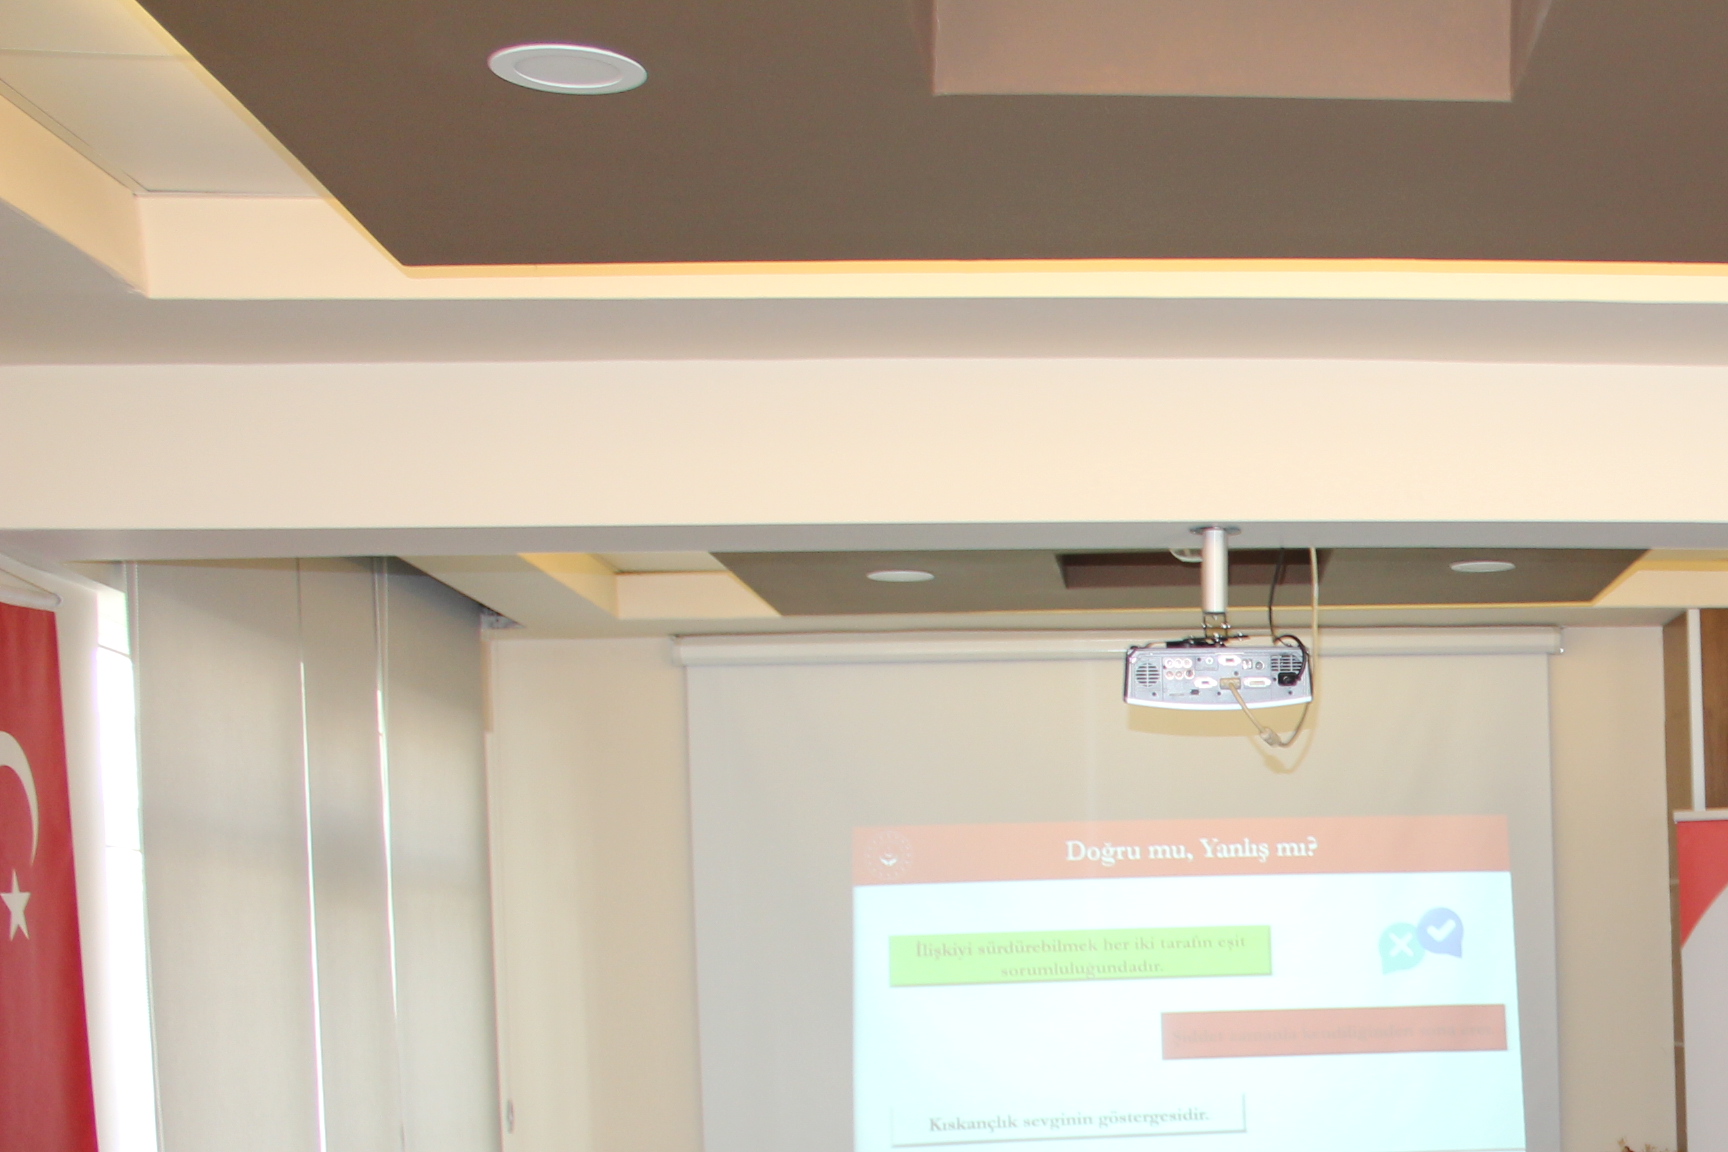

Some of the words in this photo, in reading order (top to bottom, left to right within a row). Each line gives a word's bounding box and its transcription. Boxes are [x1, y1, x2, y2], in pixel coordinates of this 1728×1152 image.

[1066, 840, 1141, 866] Doğru
[1149, 844, 1194, 862] mu,
[1200, 837, 1270, 862] Yanlış
[1276, 836, 1318, 857] mı?
[916, 938, 973, 960] İlişkiyi
[1103, 937, 1130, 953] her
[1134, 935, 1155, 951] iki
[928, 1114, 1018, 1133] Kıskançlık
[1022, 1112, 1093, 1129] sevginin
[1098, 1107, 1209, 1129] göstergesidir.
